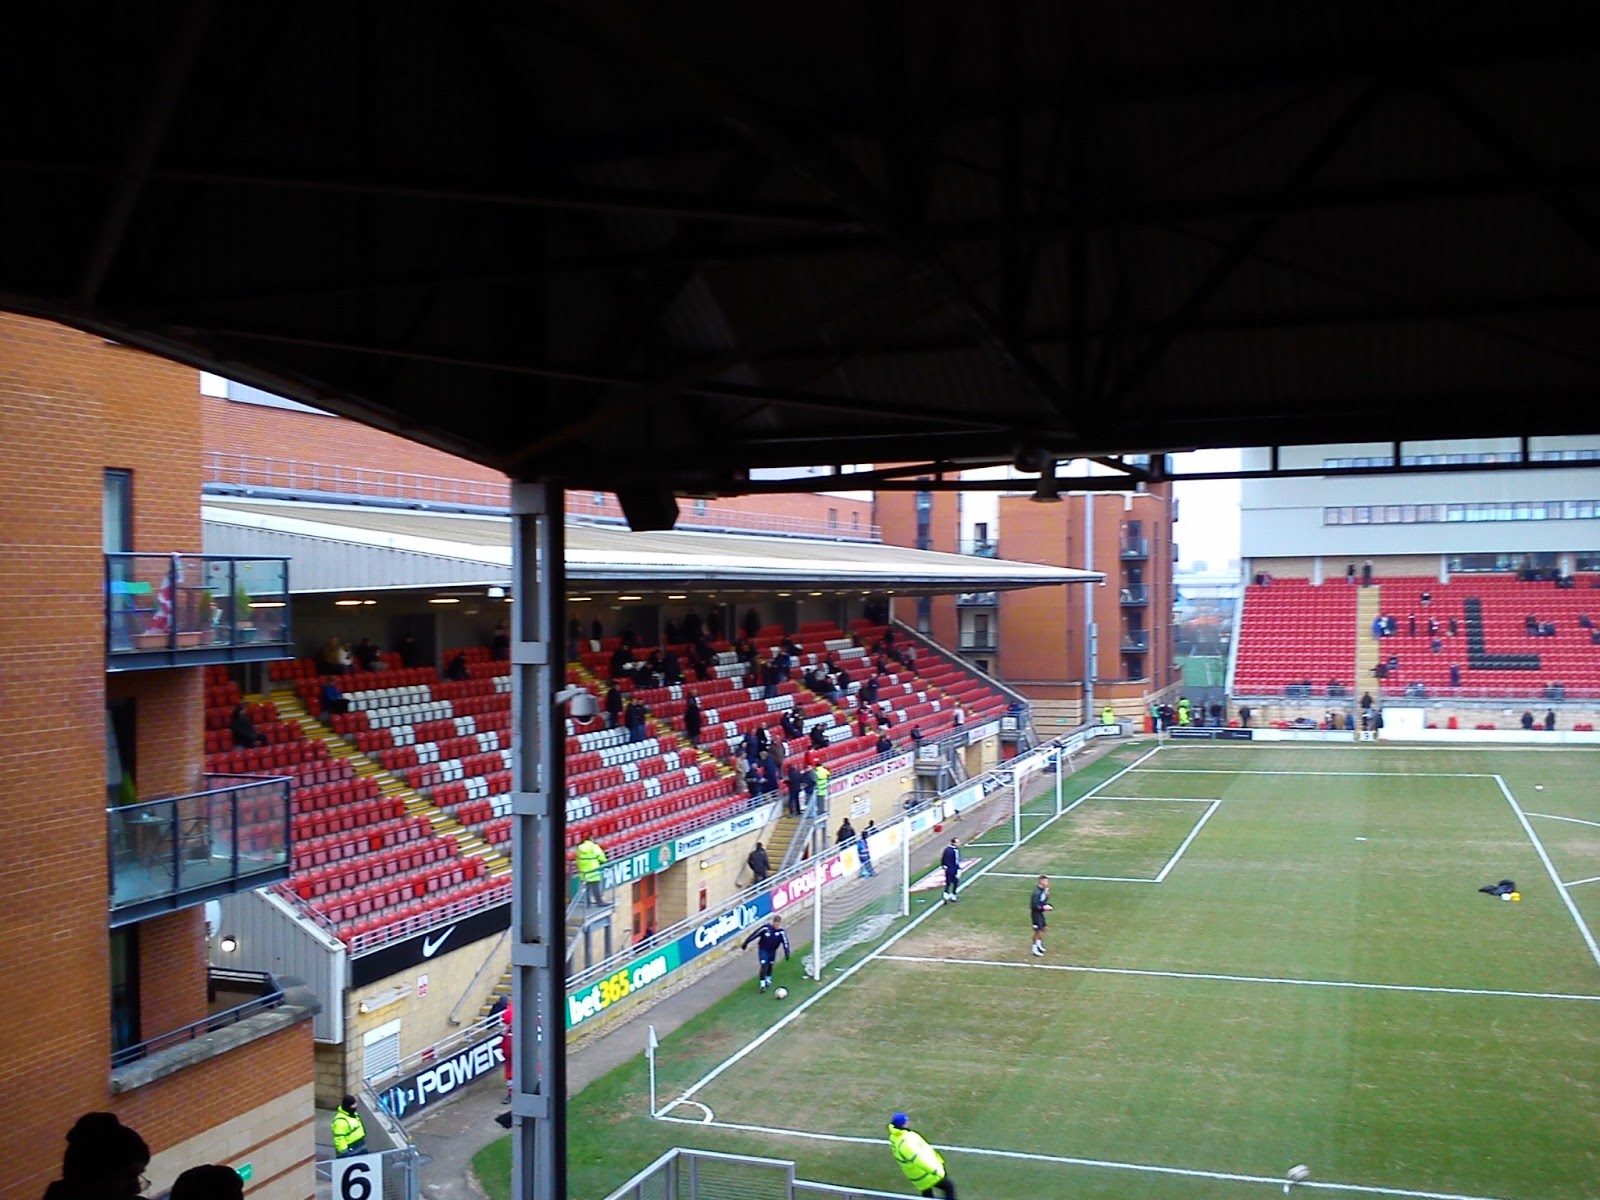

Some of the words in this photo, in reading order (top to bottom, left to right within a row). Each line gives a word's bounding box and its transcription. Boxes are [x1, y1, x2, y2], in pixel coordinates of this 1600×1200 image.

[568, 955, 667, 1025] bet365.com
[417, 1036, 506, 1105] POWER
[341, 1162, 372, 1200] 6
